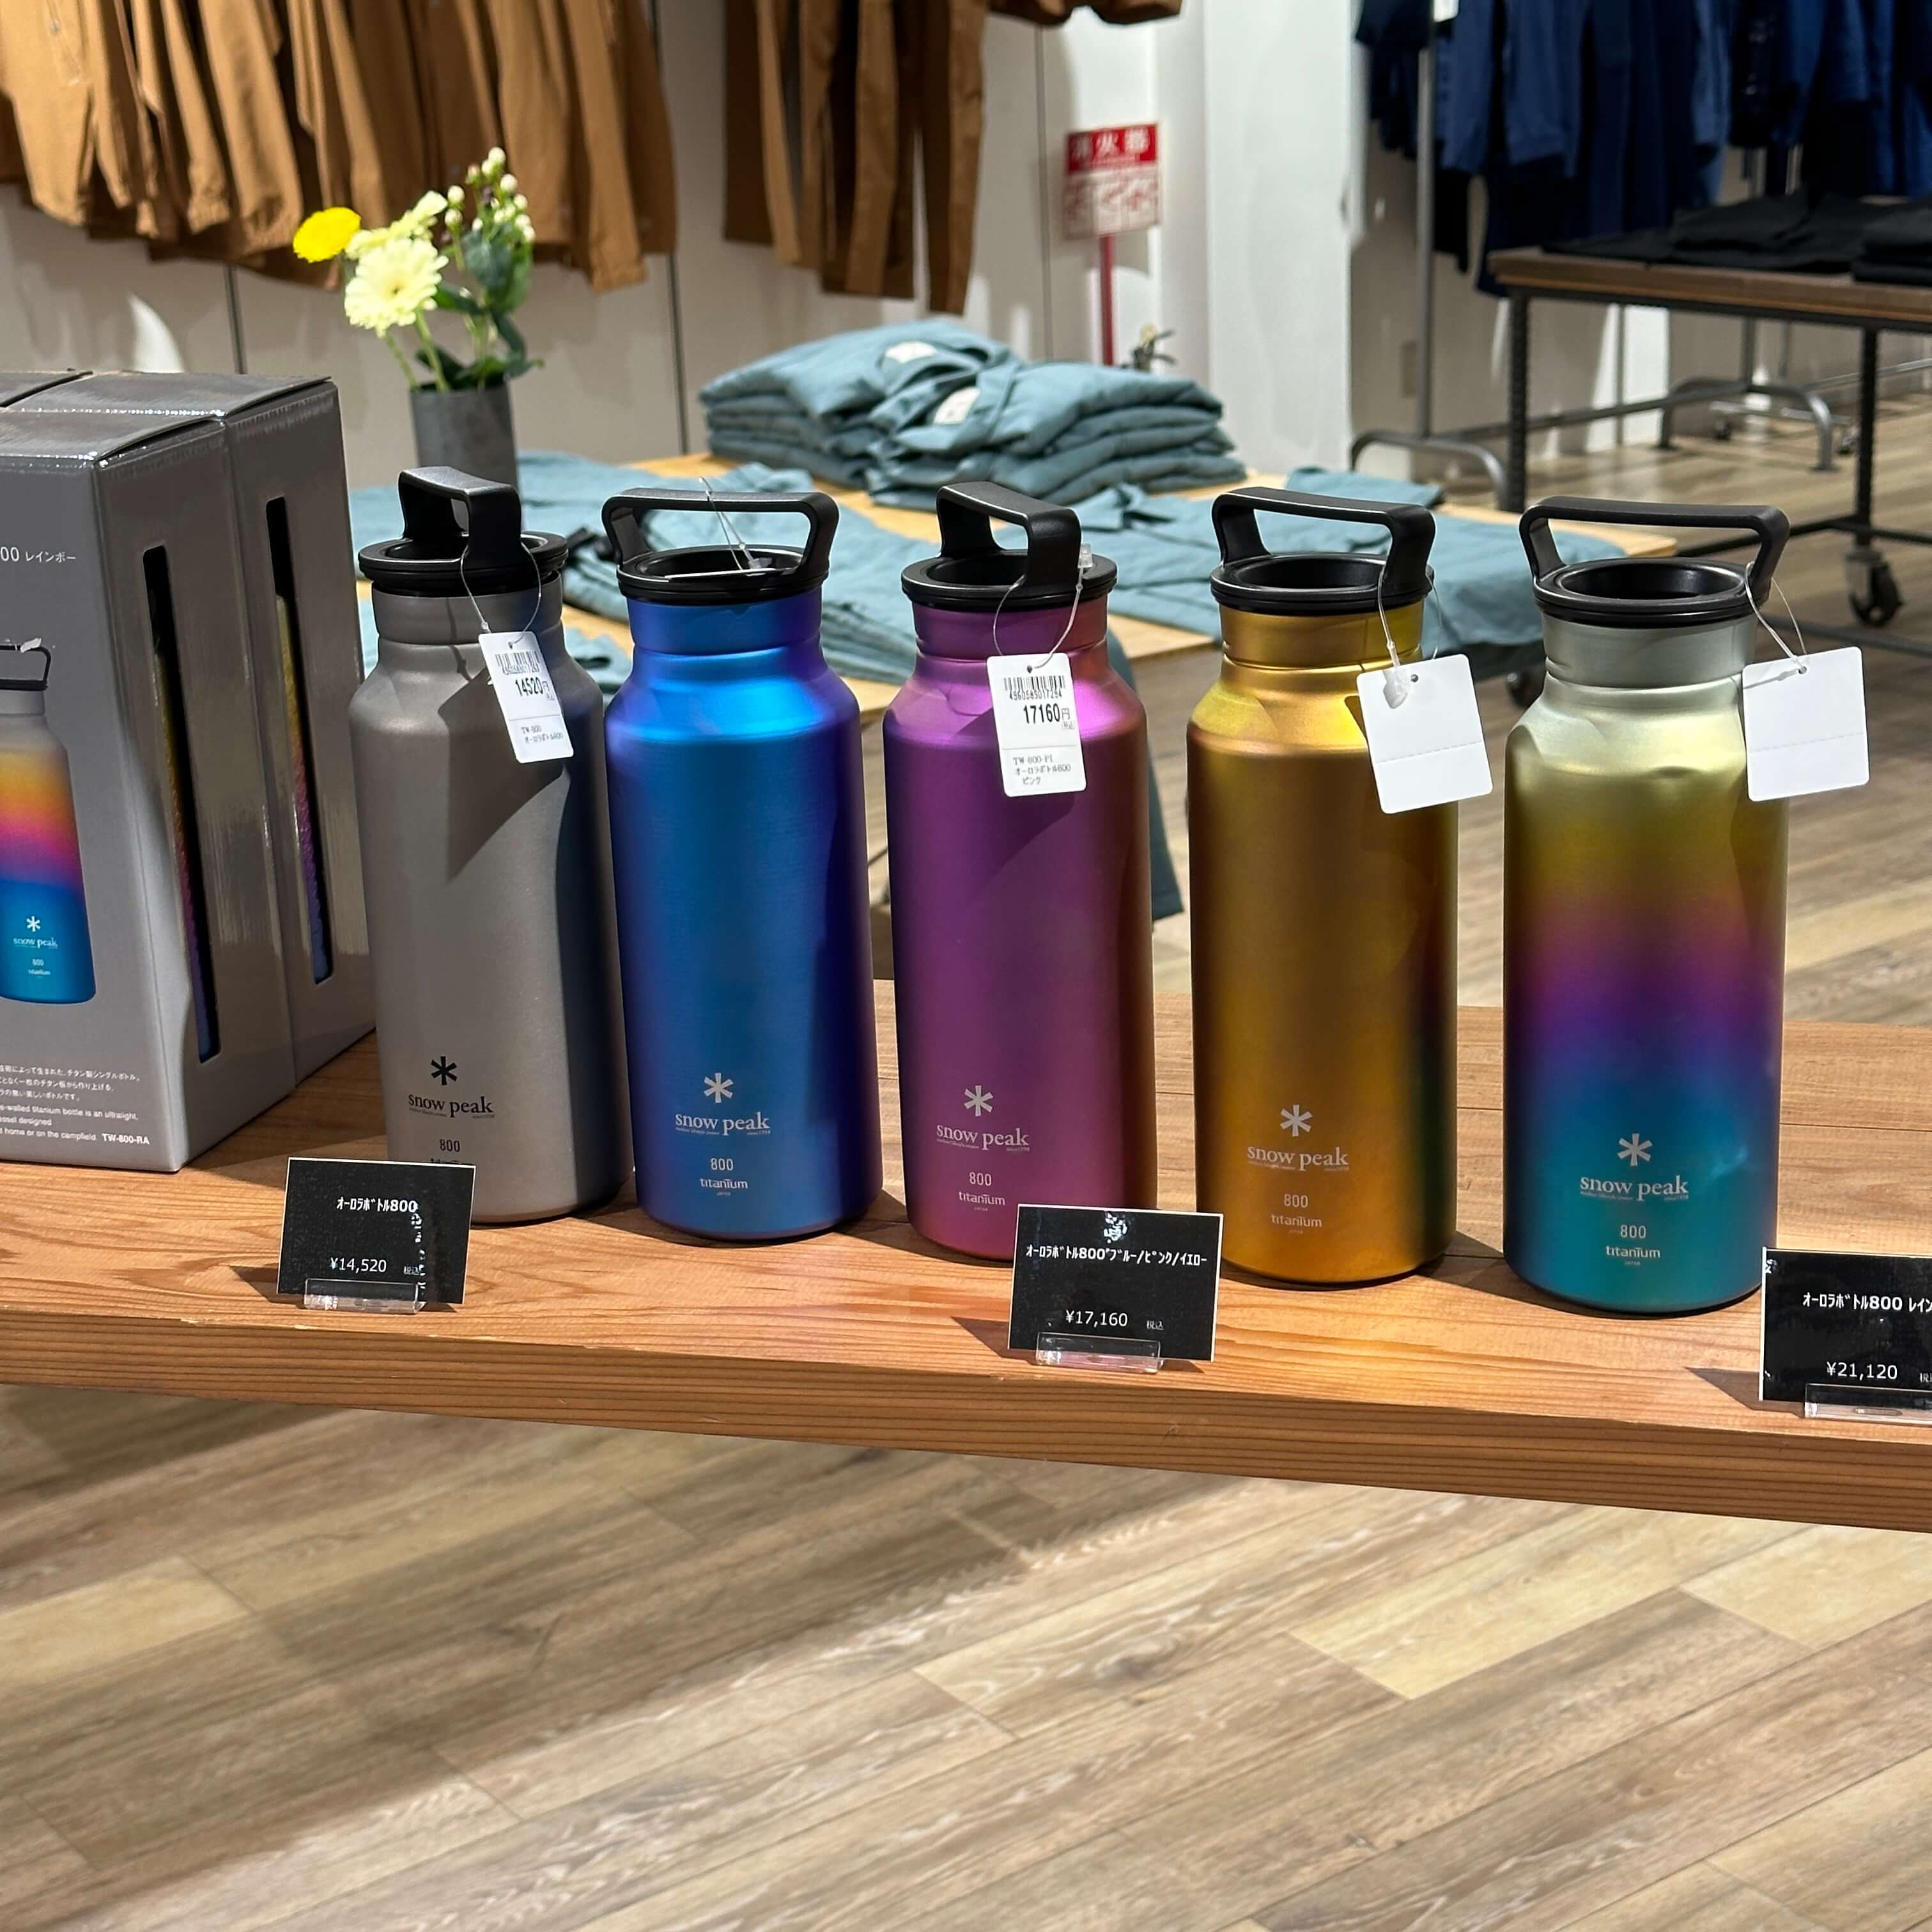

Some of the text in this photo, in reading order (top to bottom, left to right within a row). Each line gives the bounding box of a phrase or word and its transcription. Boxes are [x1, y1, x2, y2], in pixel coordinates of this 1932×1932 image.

[26, 551, 76, 562] レインボー
[1023, 777, 1041, 785] ピンク
[37, 937, 58, 948] peak
[408, 1094, 445, 1110] snow
[449, 1096, 493, 1118] peak
[676, 1114, 719, 1129] snow
[722, 1111, 771, 1136] peak
[936, 1125, 978, 1143] snow
[982, 1127, 1029, 1150] peak
[440, 1139, 460, 1152] 800
[711, 1158, 734, 1171] 800
[1248, 1147, 1295, 1164] snow
[1299, 1147, 1349, 1171] peak
[700, 1178, 748, 1189] titanium
[970, 1171, 992, 1186] 800
[1580, 1175, 1689, 1201] snow peak
[959, 1191, 1005, 1205] titanium
[1284, 1194, 1308, 1208] 800
[1271, 1214, 1322, 1227] titanium
[1620, 1225, 1646, 1238] 800
[1606, 1246, 1660, 1258] titanium
[330, 1257, 387, 1273] ¥14,520
[1065, 1310, 1164, 1331] ¥17,160 税込
[1827, 1362, 1897, 1380] ¥21,120
